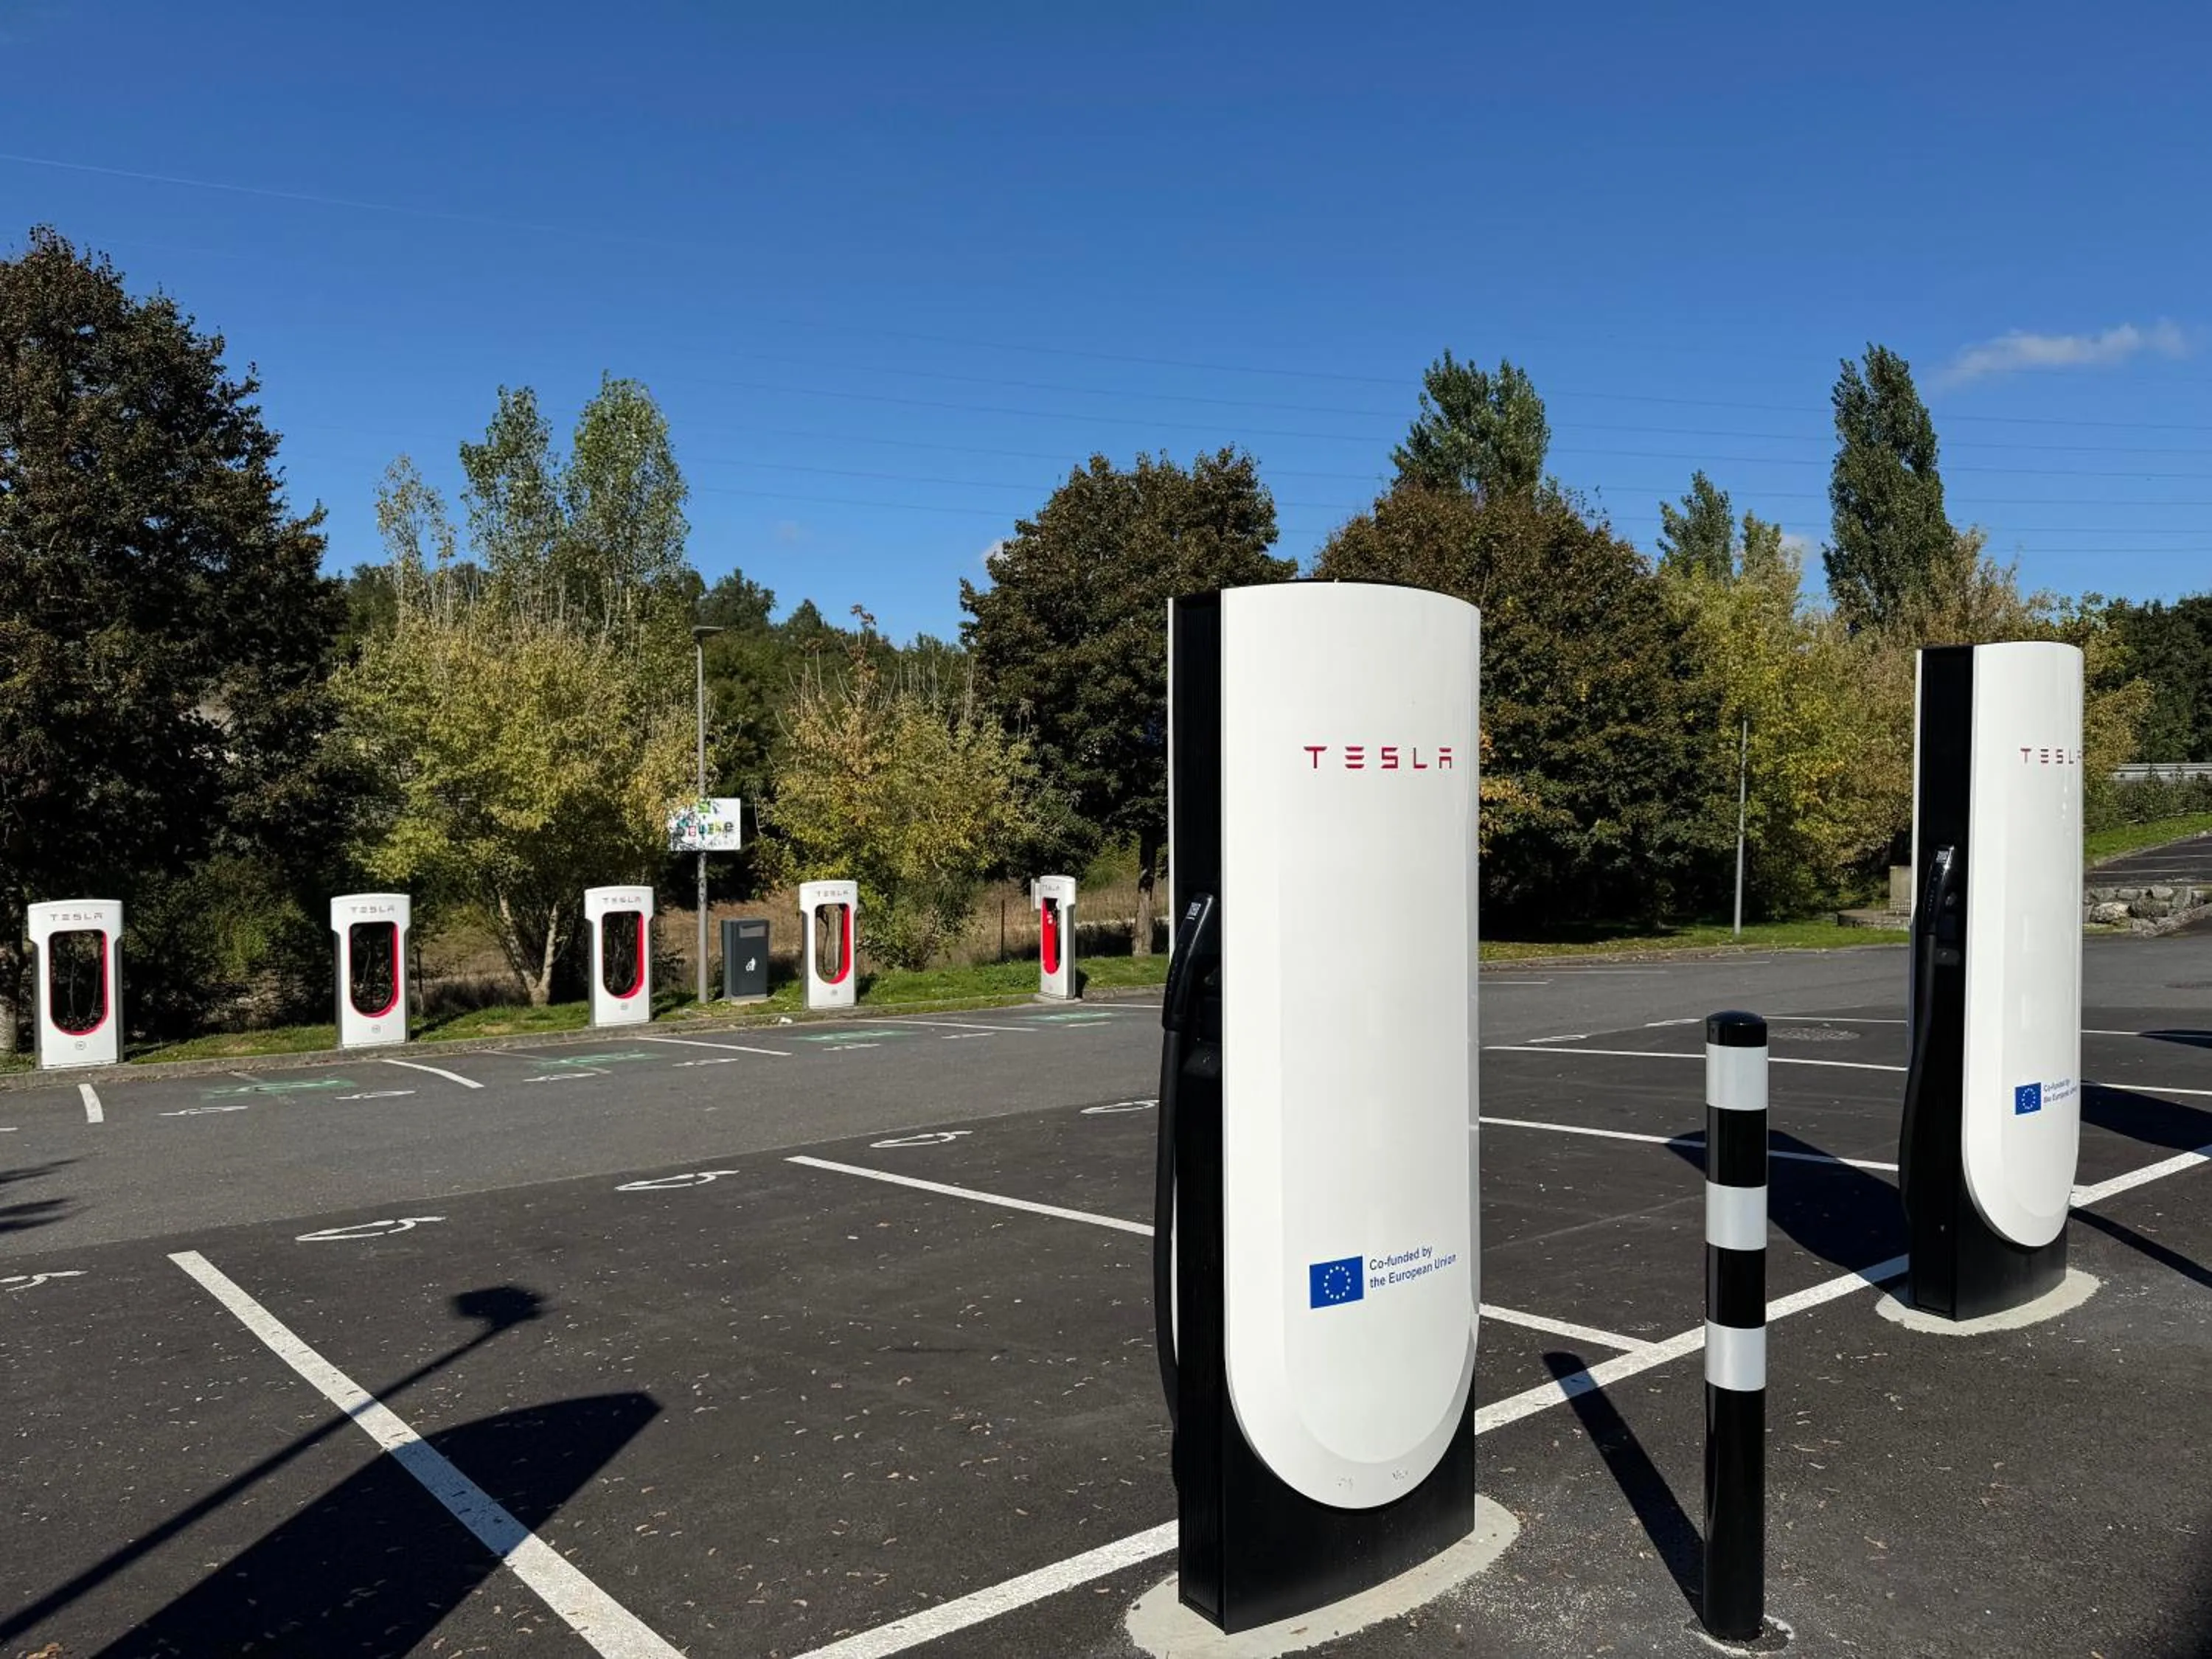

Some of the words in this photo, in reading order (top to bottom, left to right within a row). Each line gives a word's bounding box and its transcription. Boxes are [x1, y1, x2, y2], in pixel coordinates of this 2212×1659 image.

[1304, 746, 1452, 768] TESLA
[50, 912, 104, 920] TESLA
[350, 905, 395, 913] TESLA
[1369, 1248, 1419, 1270] Co-funded
[1422, 1245, 1433, 1258] by
[1369, 1276, 1386, 1288] the
[1388, 1264, 1433, 1284] European
[1434, 1254, 1457, 1269] Union
